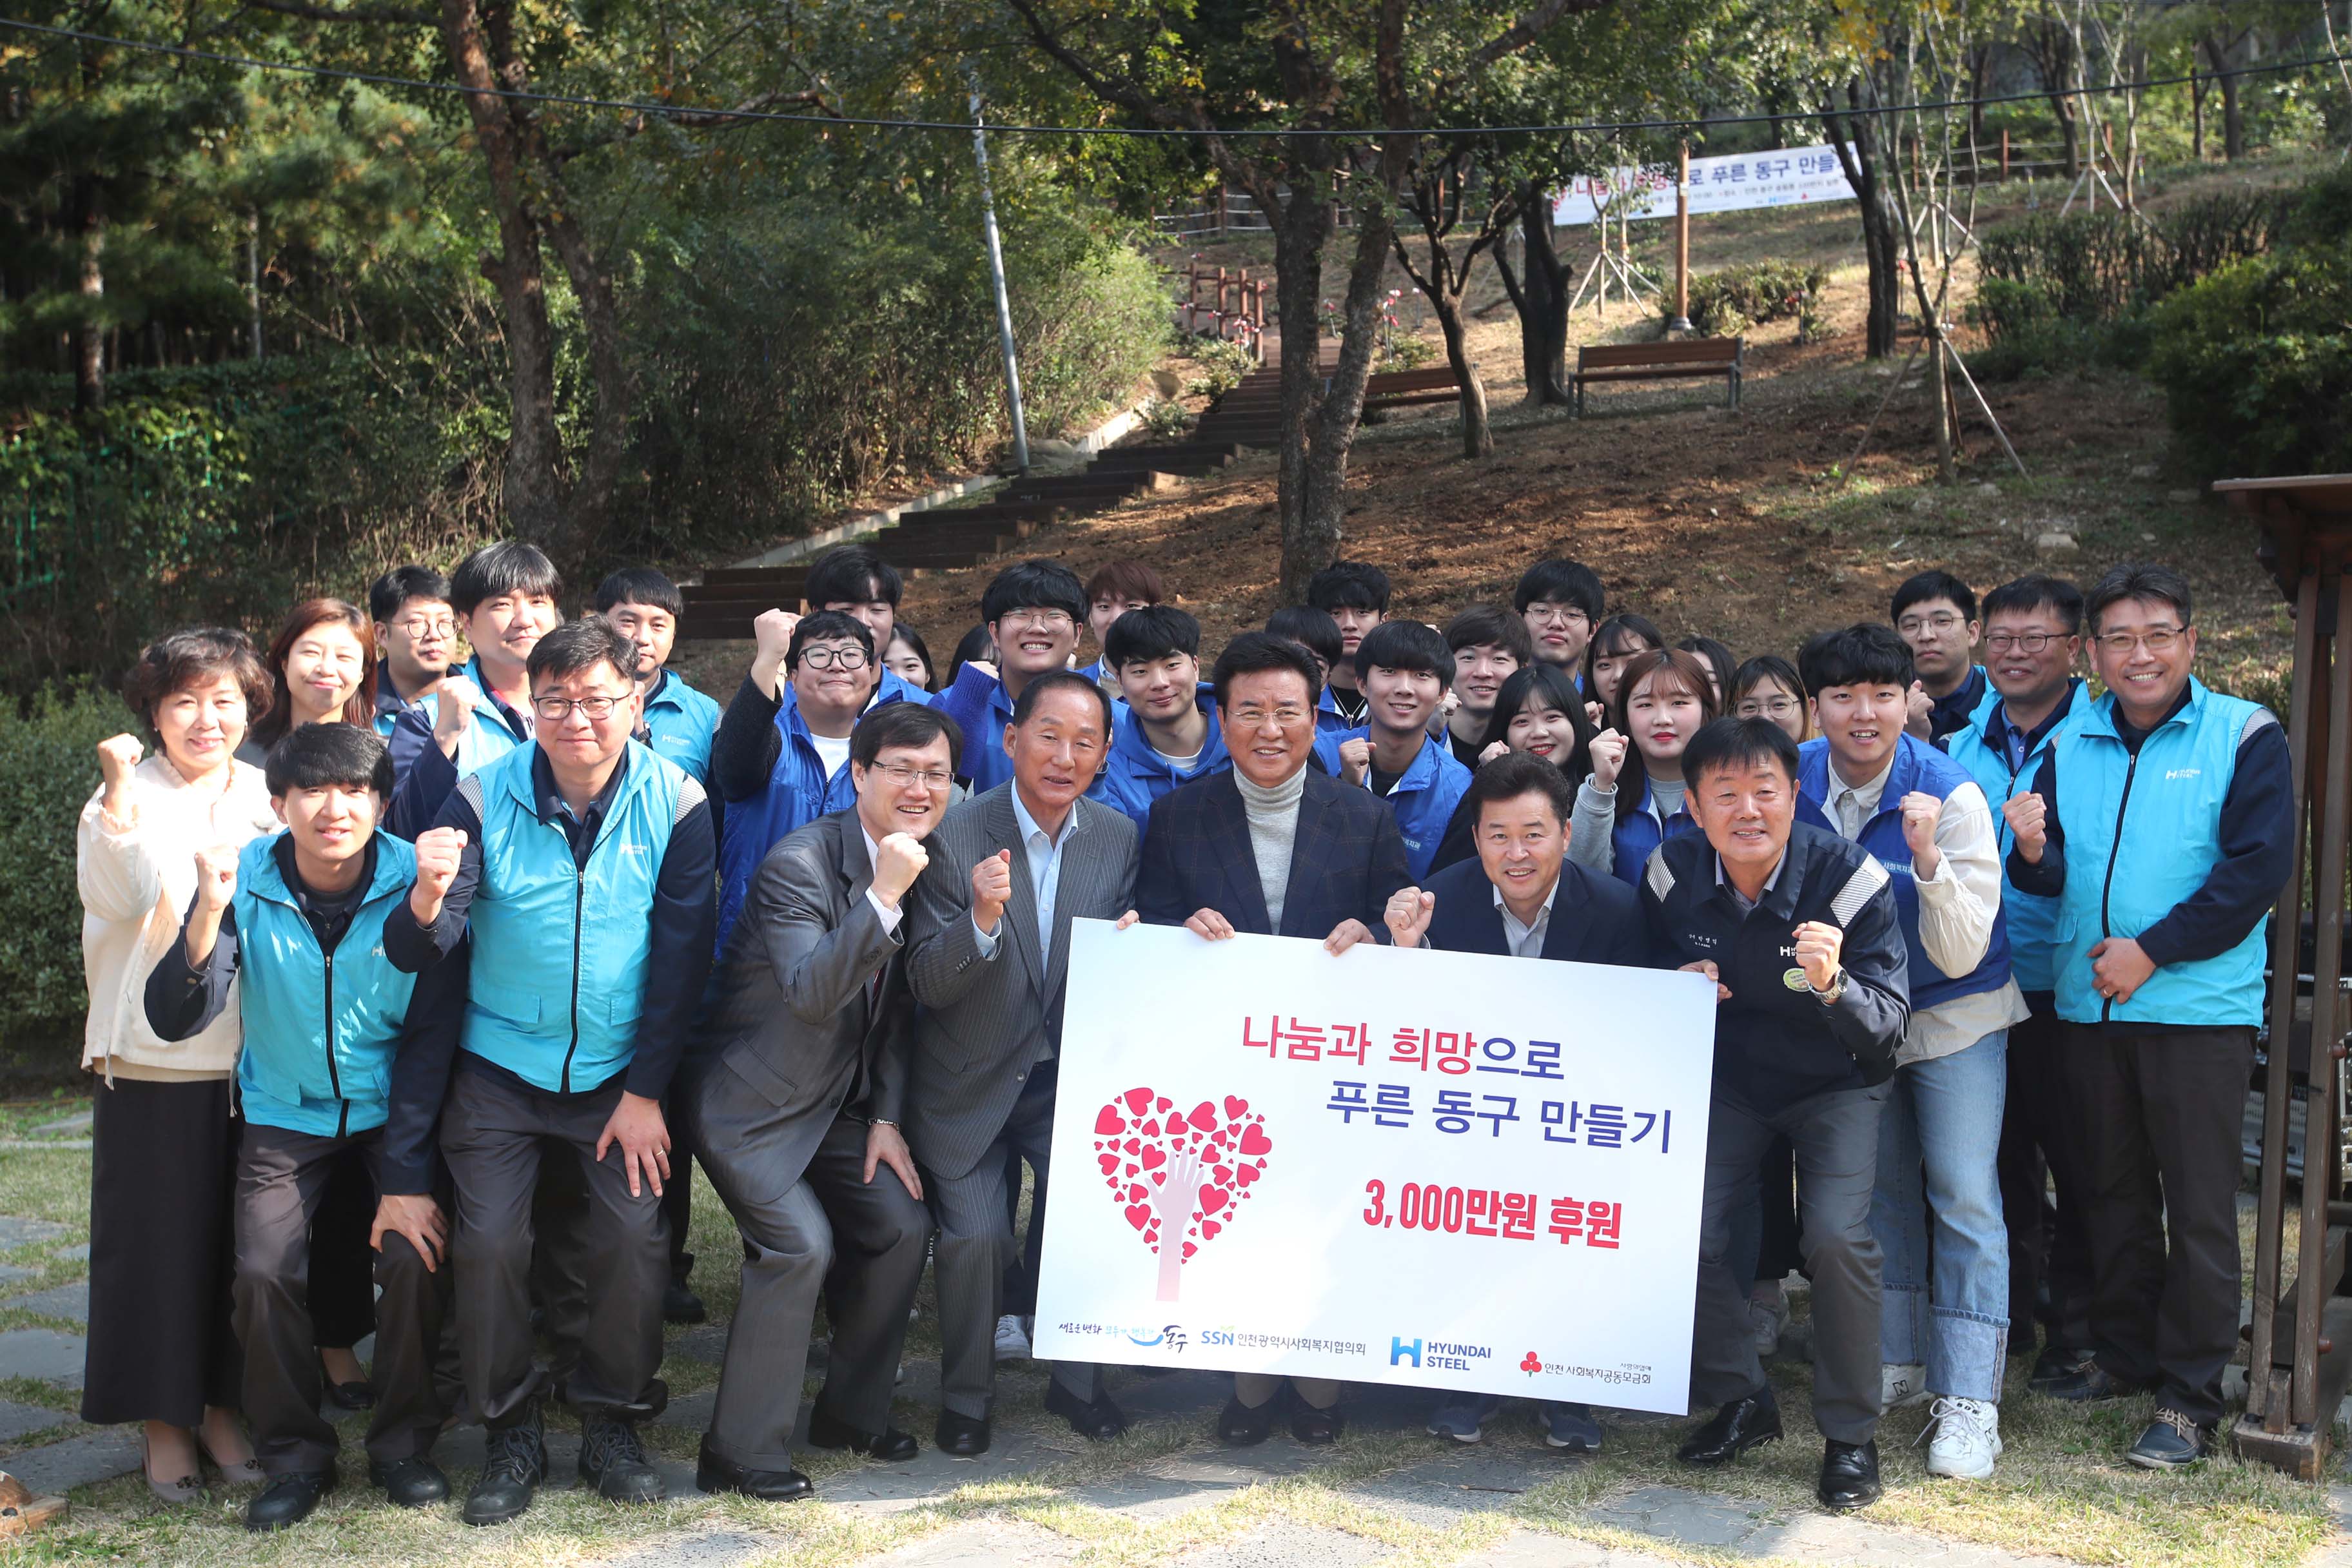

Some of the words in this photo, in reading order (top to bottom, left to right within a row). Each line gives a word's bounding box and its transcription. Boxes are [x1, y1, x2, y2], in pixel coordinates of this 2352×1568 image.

[1712, 162, 1747, 184] 푸른
[1755, 159, 1792, 181] 동구
[1799, 152, 1853, 175] 만들
[1242, 1015, 1372, 1066] 나눔과
[1389, 1028, 1565, 1080] 희망으로
[1326, 1081, 1414, 1128] 푸른
[1433, 1090, 1520, 1137] 동구
[1540, 1100, 1672, 1154] 만들기
[1363, 1179, 1538, 1241] 3,000만원
[1548, 1196, 1623, 1250] 후원
[1059, 1322, 1081, 1333] 새로운
[1083, 1324, 1102, 1335] 변화
[1163, 1325, 1188, 1353] 동구
[1201, 1331, 1234, 1346] SSN
[1238, 1333, 1366, 1355] 인천광역시사회복지협의회
[1427, 1342, 1491, 1358] HYUNDAI
[1427, 1356, 1471, 1371] STEEL
[1545, 1363, 1564, 1375] 인천
[1565, 1366, 1652, 1384] 사회복지공동모금회
